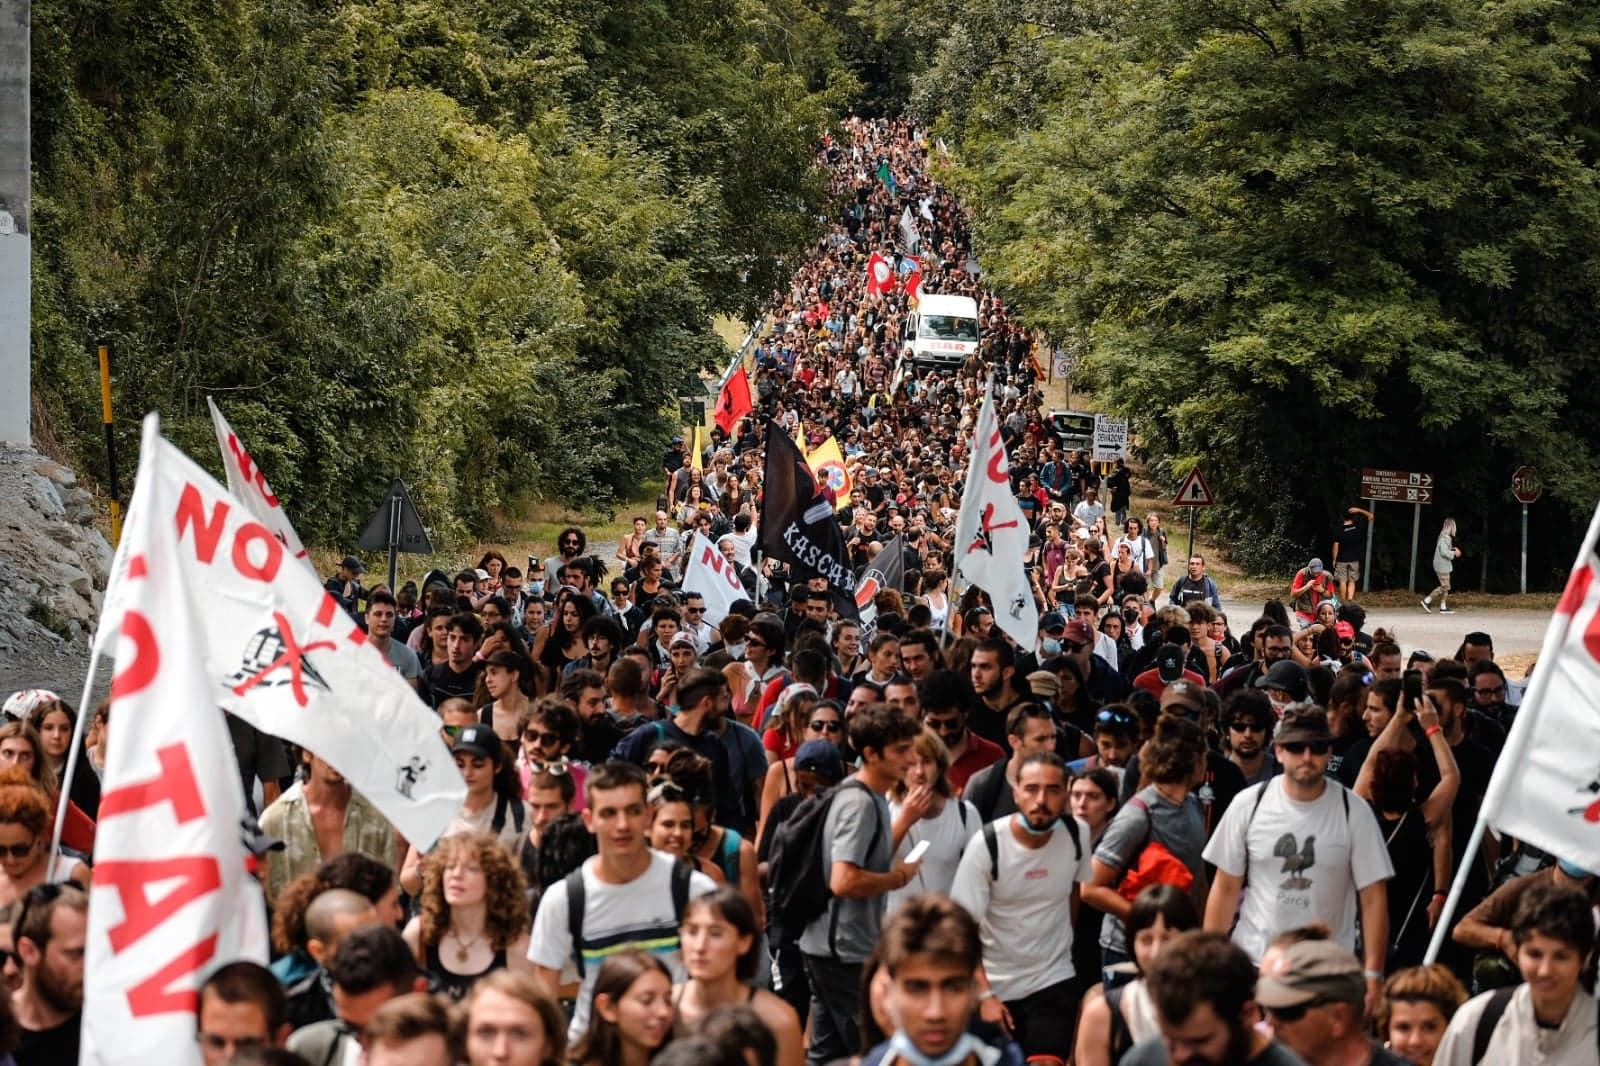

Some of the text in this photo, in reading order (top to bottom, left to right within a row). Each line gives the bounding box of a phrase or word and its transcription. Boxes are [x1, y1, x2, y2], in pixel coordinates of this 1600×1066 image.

[175, 482, 284, 584] NO
[702, 546, 741, 590] NO
[92, 741, 223, 1018] TAV
